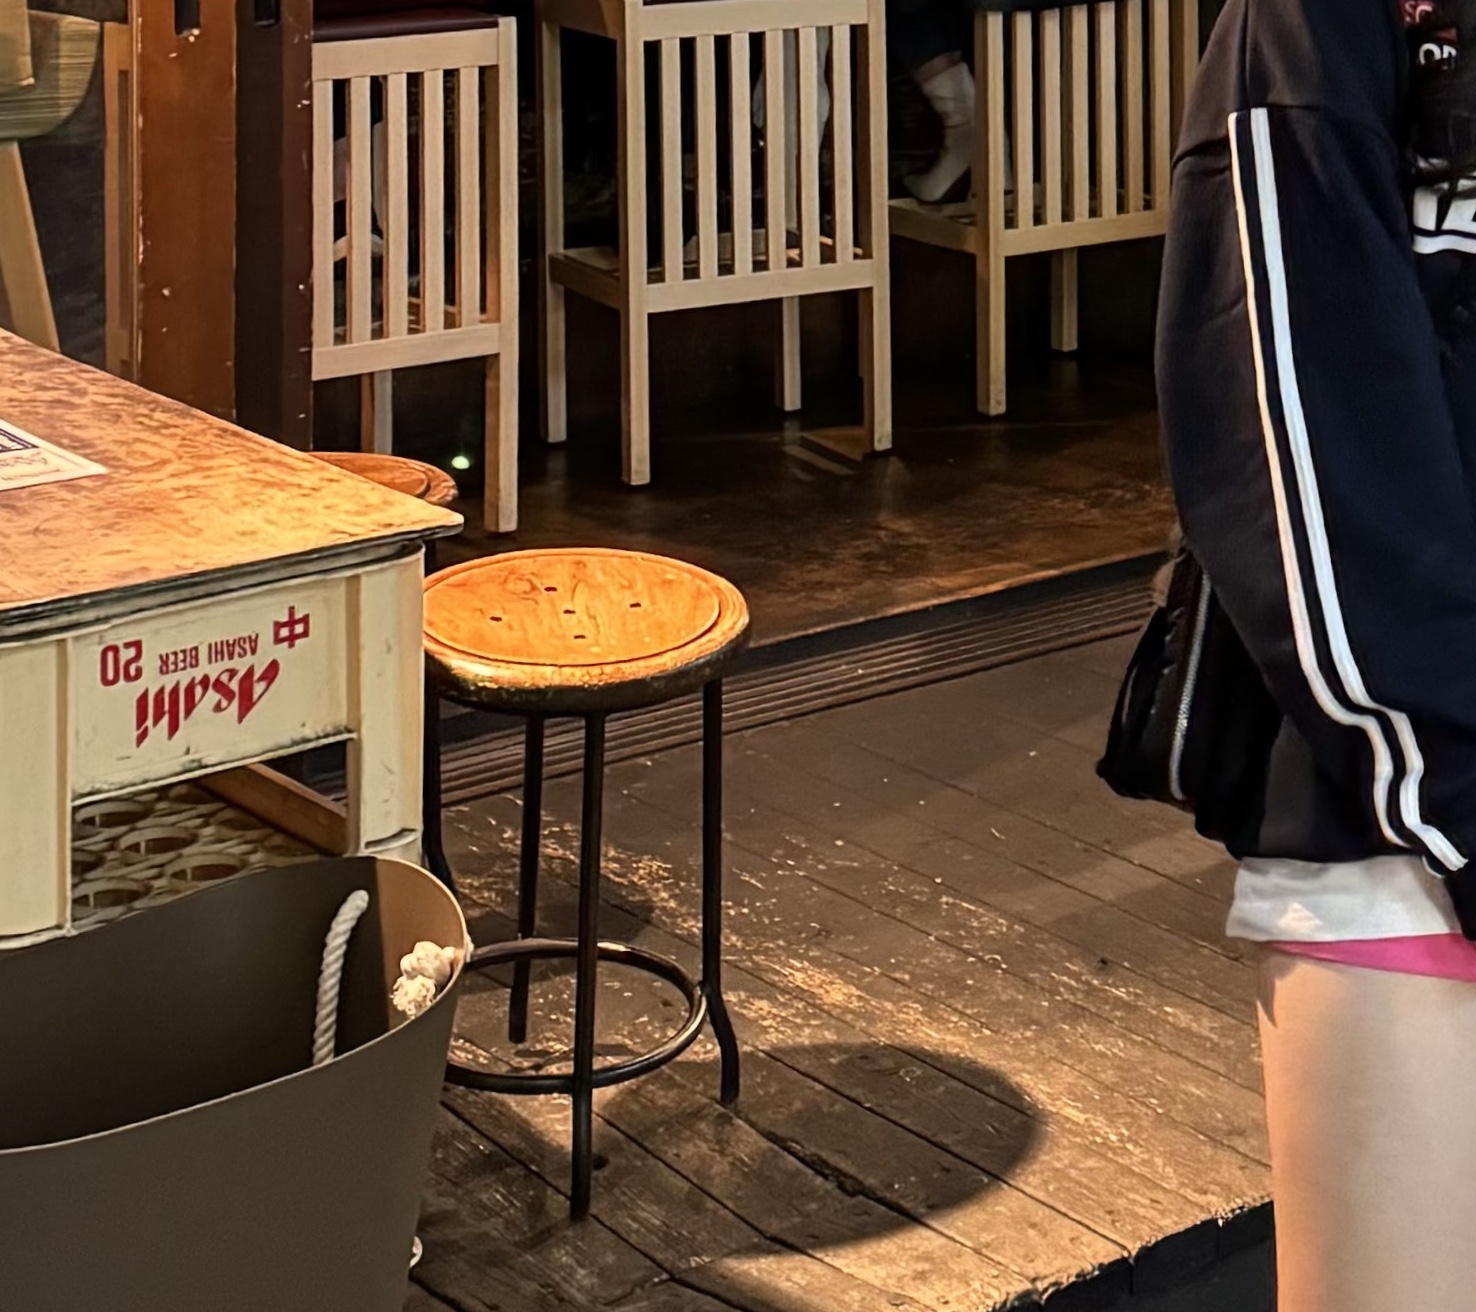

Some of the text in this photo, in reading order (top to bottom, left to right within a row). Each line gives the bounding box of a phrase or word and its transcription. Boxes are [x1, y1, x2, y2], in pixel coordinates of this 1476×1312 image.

[100, 605, 310, 687] 中 ASAHI BEER 20
[135, 658, 280, 749] Asahi
